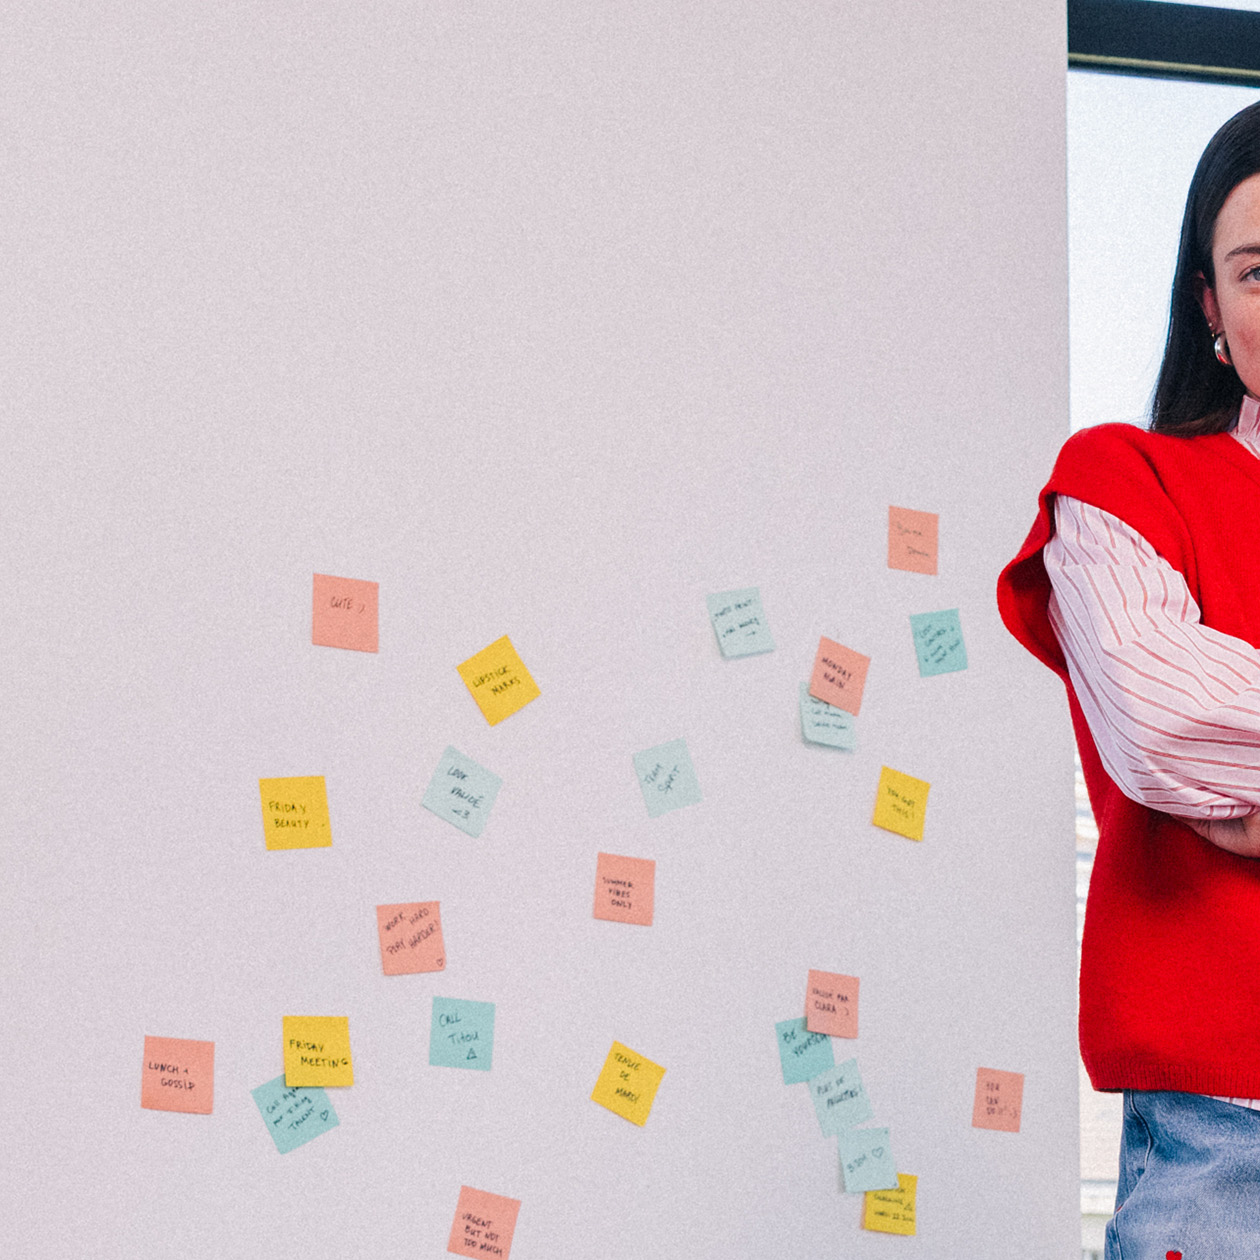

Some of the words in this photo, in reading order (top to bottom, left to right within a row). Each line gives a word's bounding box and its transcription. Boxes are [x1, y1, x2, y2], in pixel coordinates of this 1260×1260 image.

[330, 596, 353, 610] CUTE
[821, 657, 852, 680] MONDAY
[472, 665, 509, 688] LIPSTICK
[491, 677, 521, 696] MARKS
[643, 763, 664, 784] TEAM
[268, 801, 307, 815] FRIDAY
[274, 817, 309, 829] BEAUTY
[602, 876, 633, 888] SUMMER
[608, 888, 630, 898] VIBES
[611, 899, 632, 909] ONLY
[385, 911, 406, 931] WORK
[409, 907, 430, 925] HARD
[386, 938, 406, 956] PLAY
[814, 999, 837, 1014] CLARA
[438, 1013, 461, 1027] CALL
[289, 1038, 324, 1053] FRIDAY
[148, 1061, 179, 1074] LUNCH
[300, 1055, 349, 1068] MEETING
[160, 1077, 195, 1090] GOSSIP
[462, 1213, 493, 1230] URGENT
[464, 1225, 482, 1238] BUT
[484, 1231, 499, 1243] NOT
[464, 1237, 477, 1248] TOO
[479, 1242, 503, 1258] MUCH
